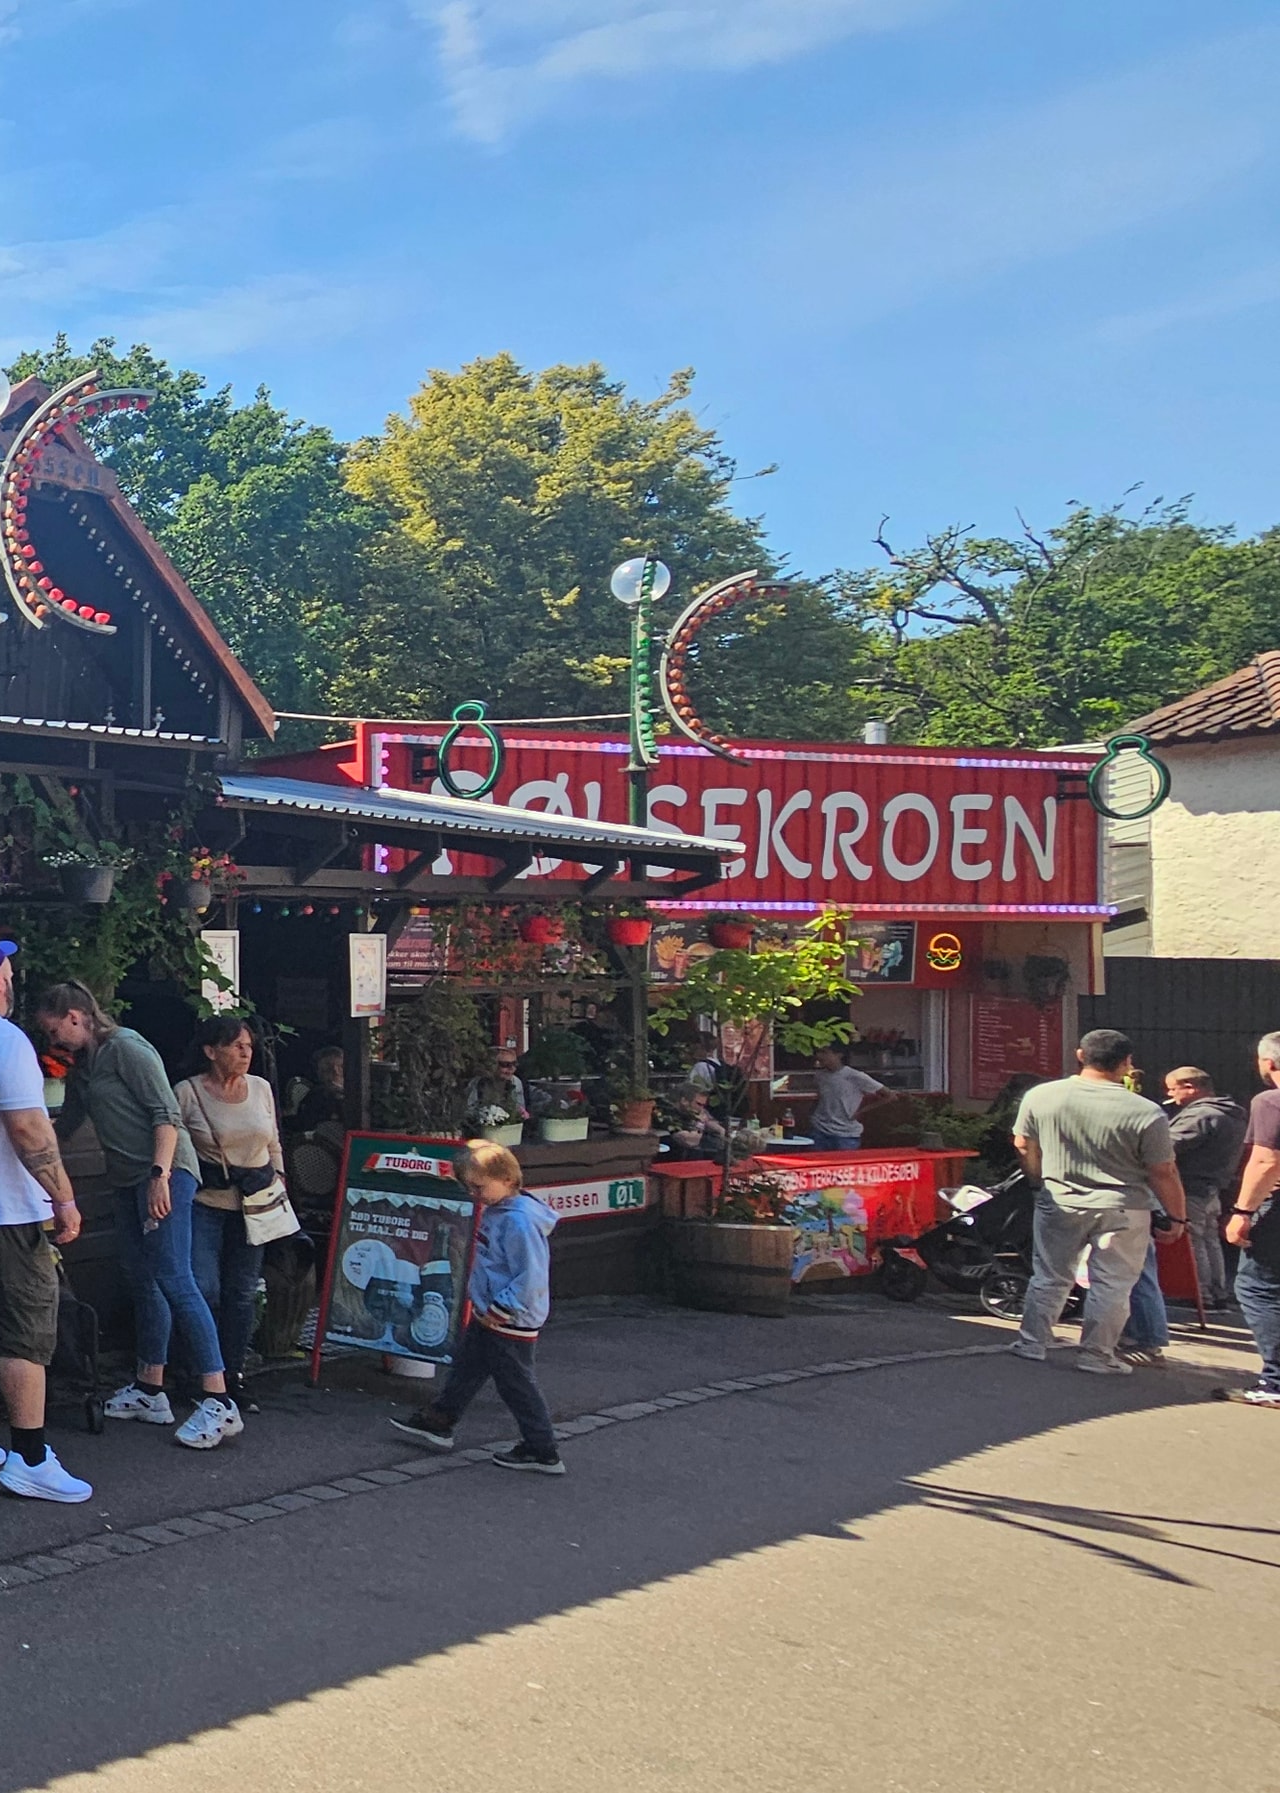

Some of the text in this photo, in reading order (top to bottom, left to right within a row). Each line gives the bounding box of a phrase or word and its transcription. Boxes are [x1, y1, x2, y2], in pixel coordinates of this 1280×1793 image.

[385, 1156, 432, 1171] TUBORG
[544, 1185, 638, 1211] kassen ØL
[349, 1221, 366, 1233] TIL
[372, 1213, 411, 1228] TUBORG
